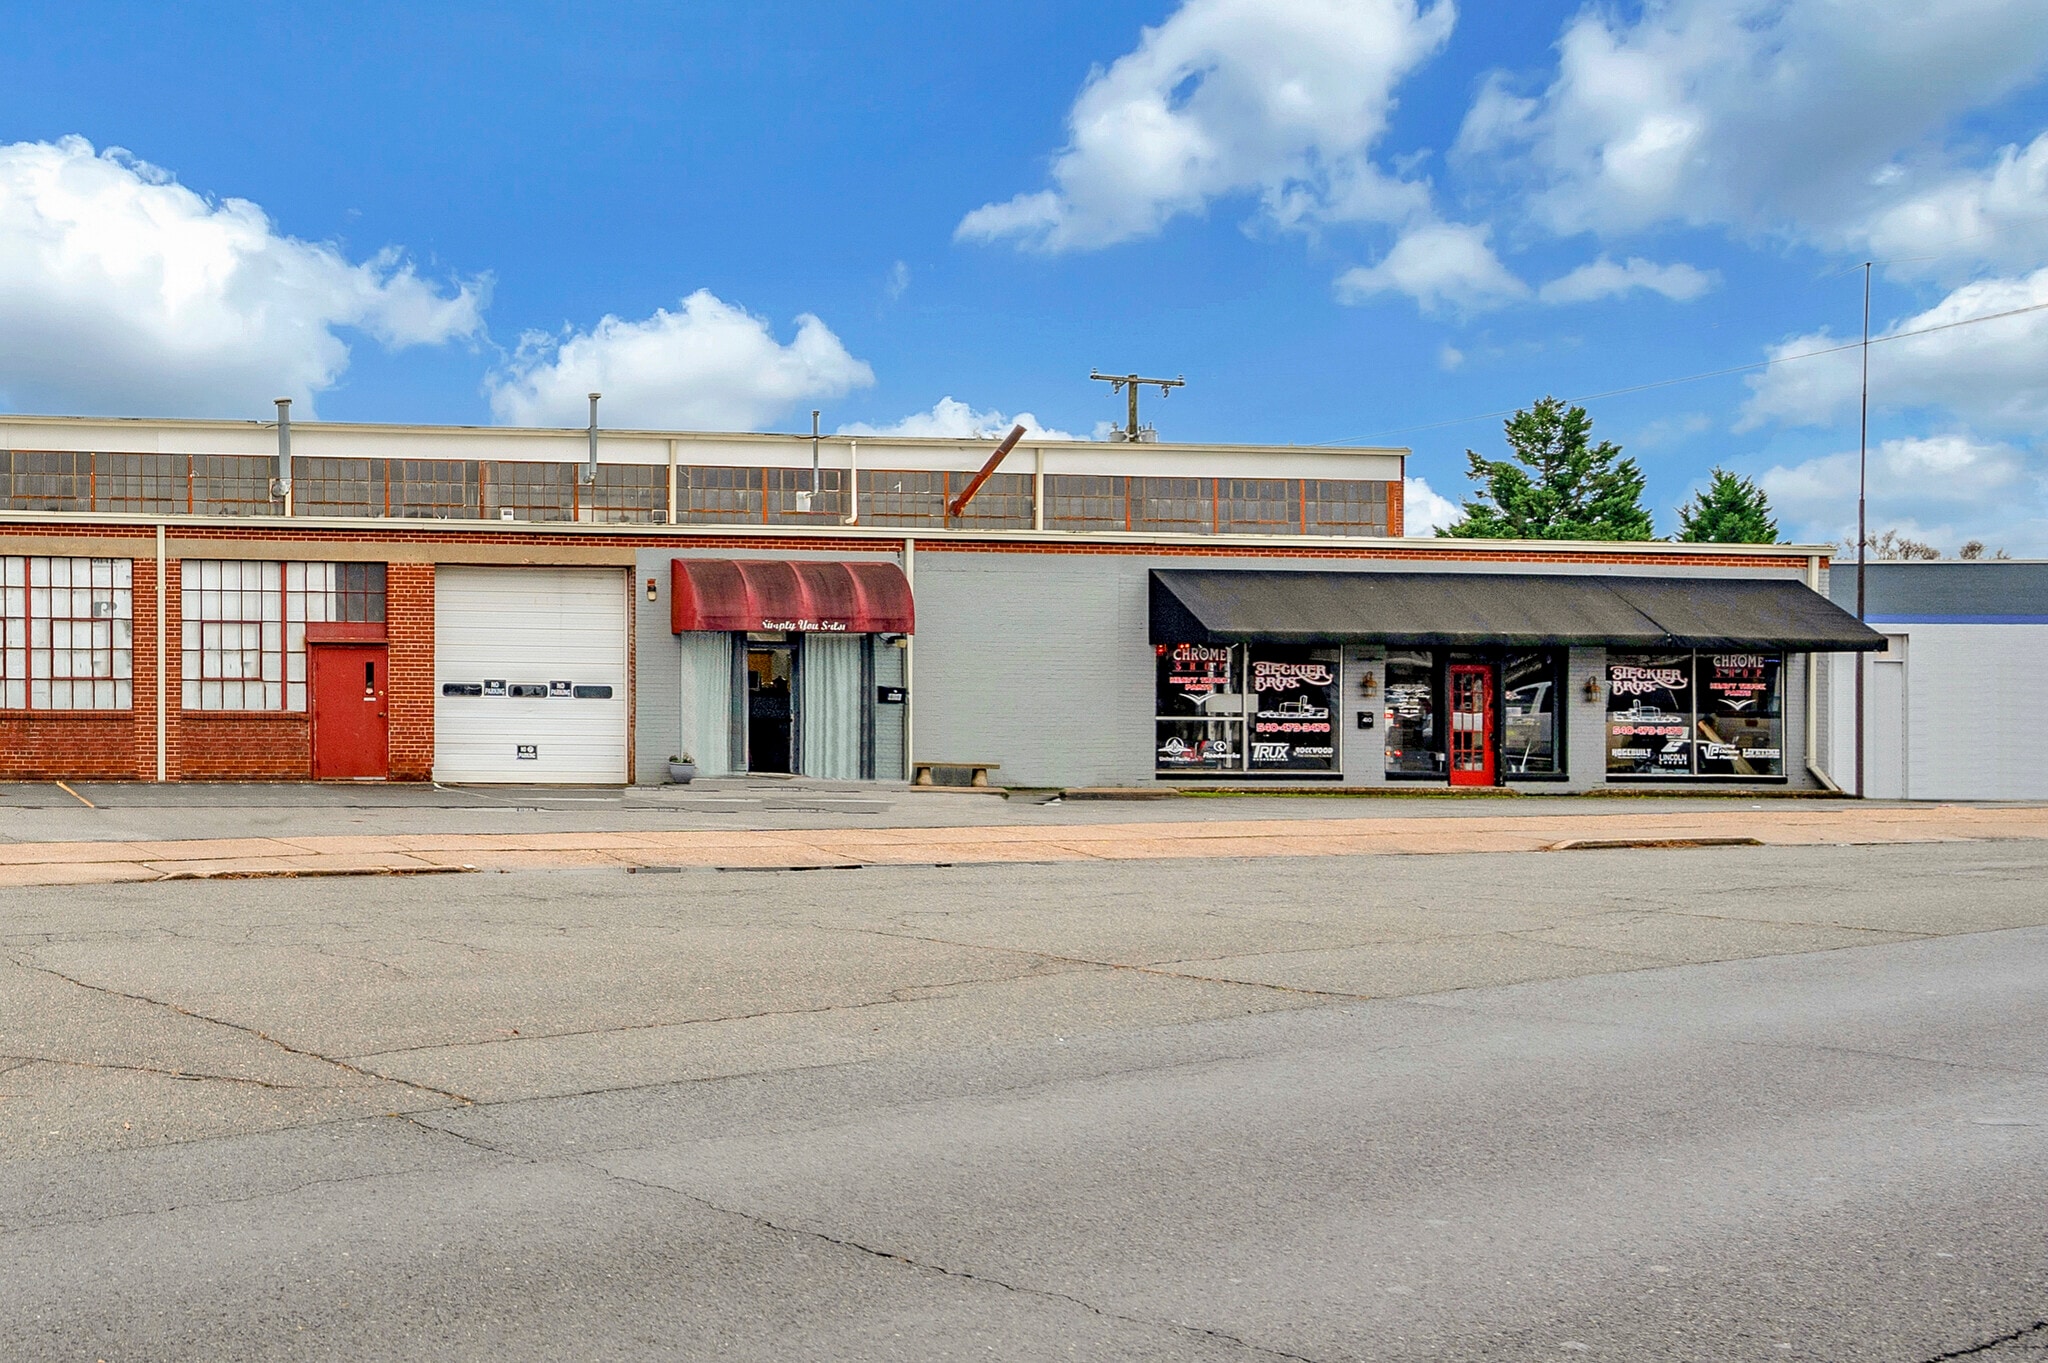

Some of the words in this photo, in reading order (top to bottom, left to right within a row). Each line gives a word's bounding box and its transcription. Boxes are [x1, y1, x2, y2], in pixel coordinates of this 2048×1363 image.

[798, 619, 819, 631] You
[1173, 648, 1227, 661] CHROME
[1713, 655, 1765, 668] CHROME
[1716, 668, 1762, 678] SHOP
[1251, 742, 1290, 758] TRUX
